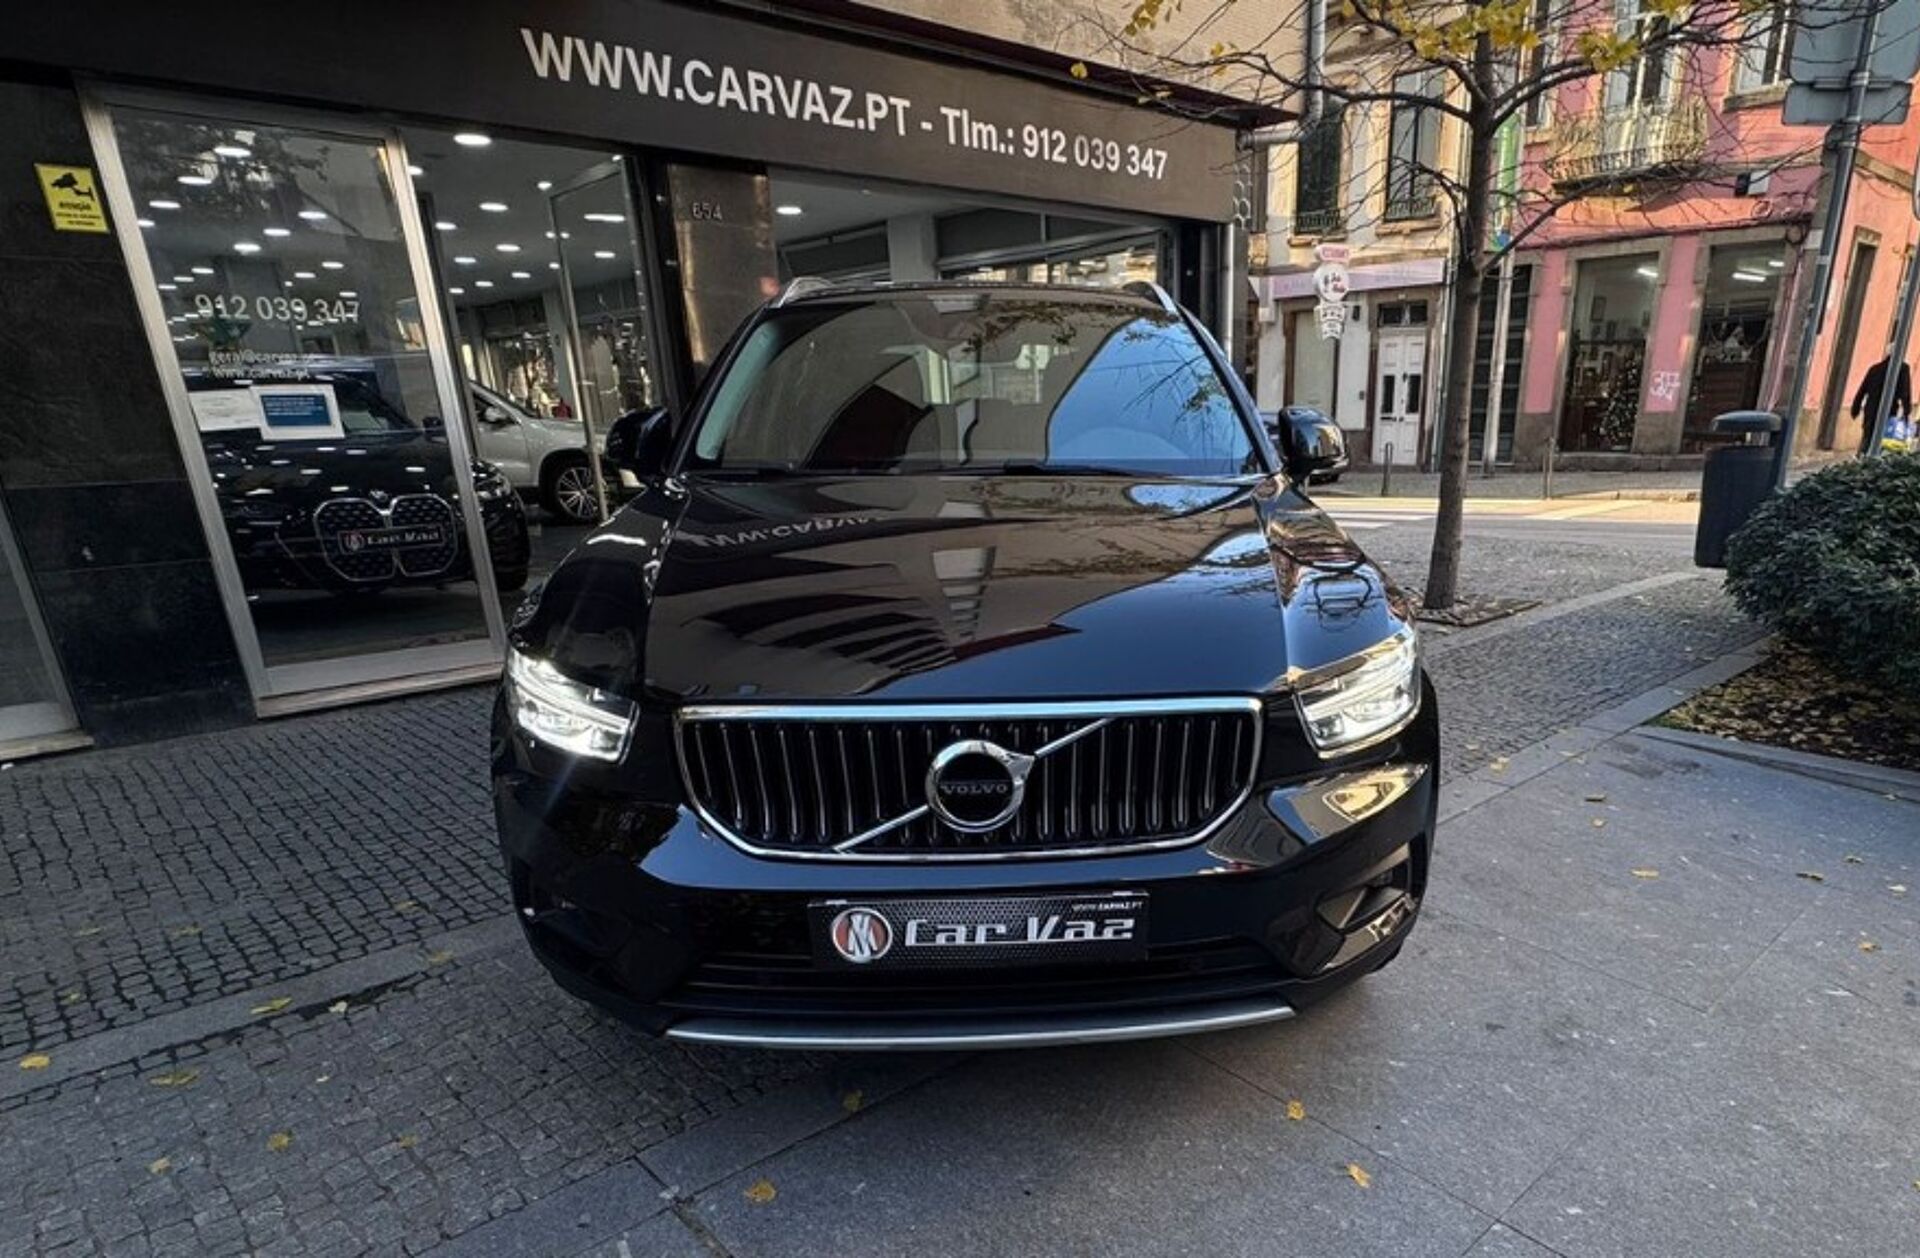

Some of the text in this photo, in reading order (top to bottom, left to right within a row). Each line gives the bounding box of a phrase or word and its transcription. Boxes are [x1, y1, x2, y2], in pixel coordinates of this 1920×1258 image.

[521, 28, 910, 136] WWW.CARVAZ.PT
[940, 106, 1015, 155] Tlm.:
[1023, 124, 1067, 164] 912
[1075, 134, 1120, 172] 039
[1127, 145, 1169, 179] 347
[693, 202, 722, 220] 654
[195, 294, 359, 323] 912 039 347
[940, 783, 1008, 795] VOLVO
[905, 919, 1006, 946] Car
